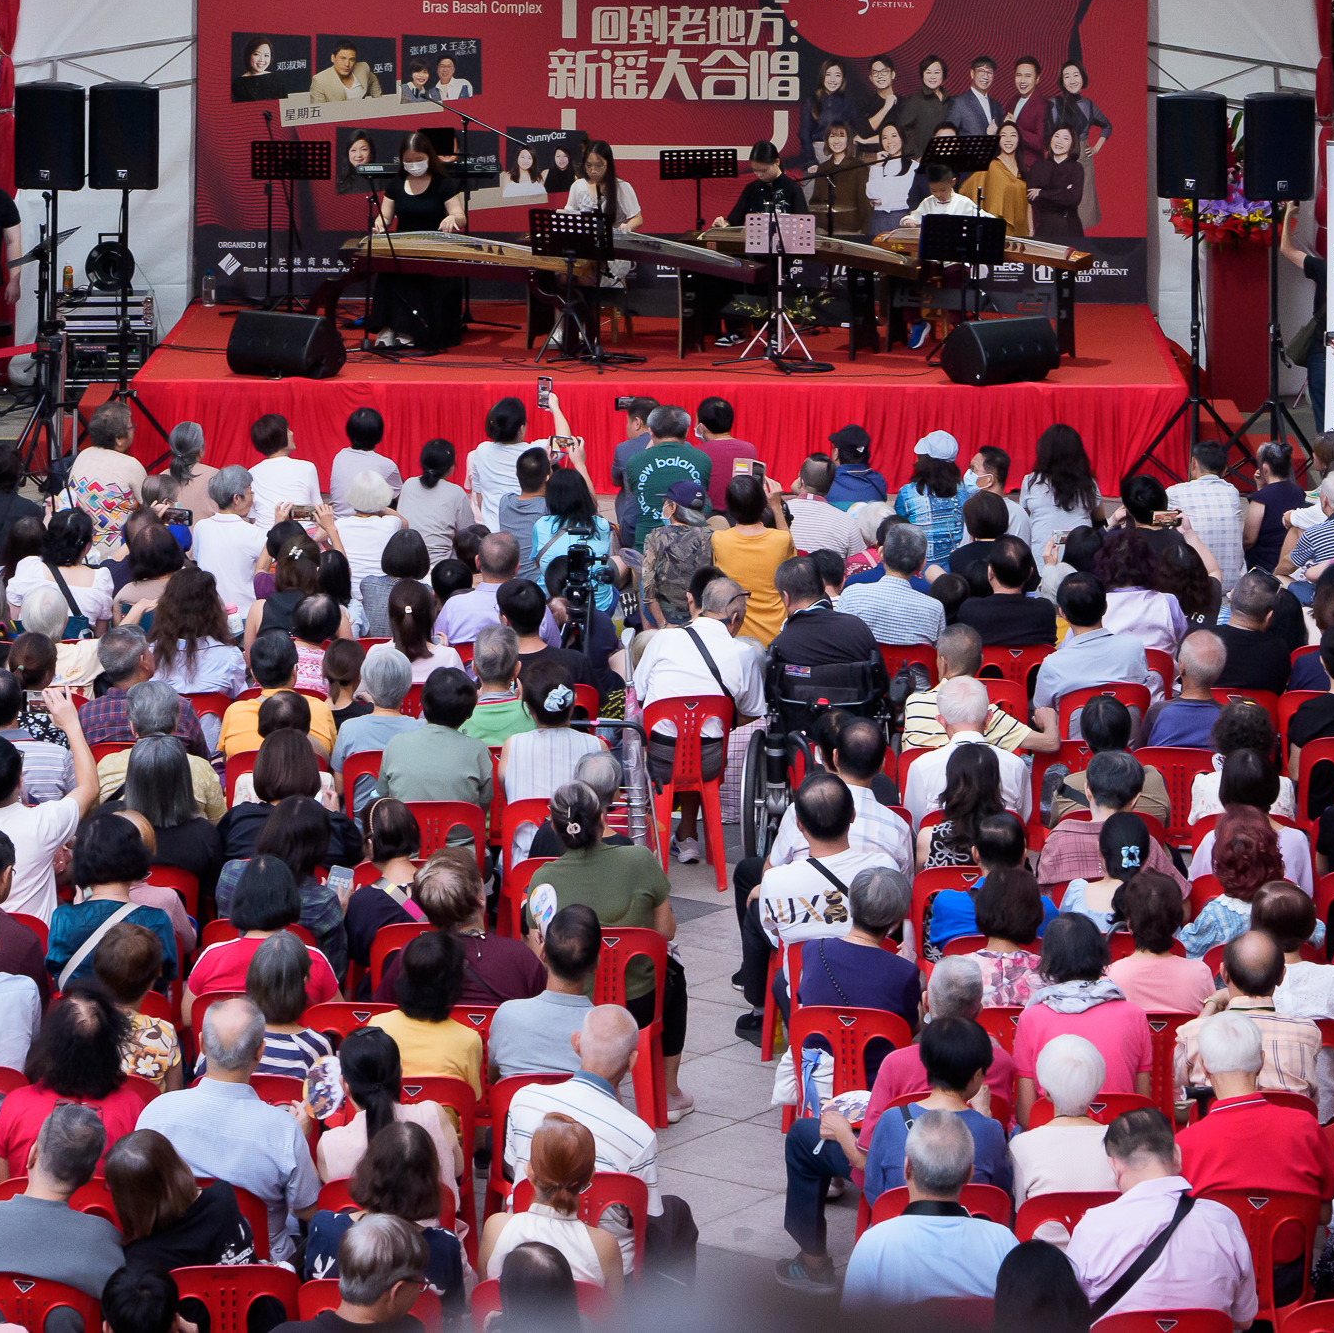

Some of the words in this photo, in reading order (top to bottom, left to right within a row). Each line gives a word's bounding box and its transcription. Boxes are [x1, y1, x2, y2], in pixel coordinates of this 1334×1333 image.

[422, 0, 449, 13] Bras
[452, 0, 487, 14] Basah
[491, 1, 543, 16] Complex
[872, 1, 915, 9] FESTIVAL
[591, 5, 799, 46] 回到老地方:
[548, 48, 800, 101] 新谣大合唱
[285, 106, 321, 122] 星期五
[526, 131, 567, 143] SunnyCaz
[637, 463, 654, 491] new
[655, 456, 702, 486] balance
